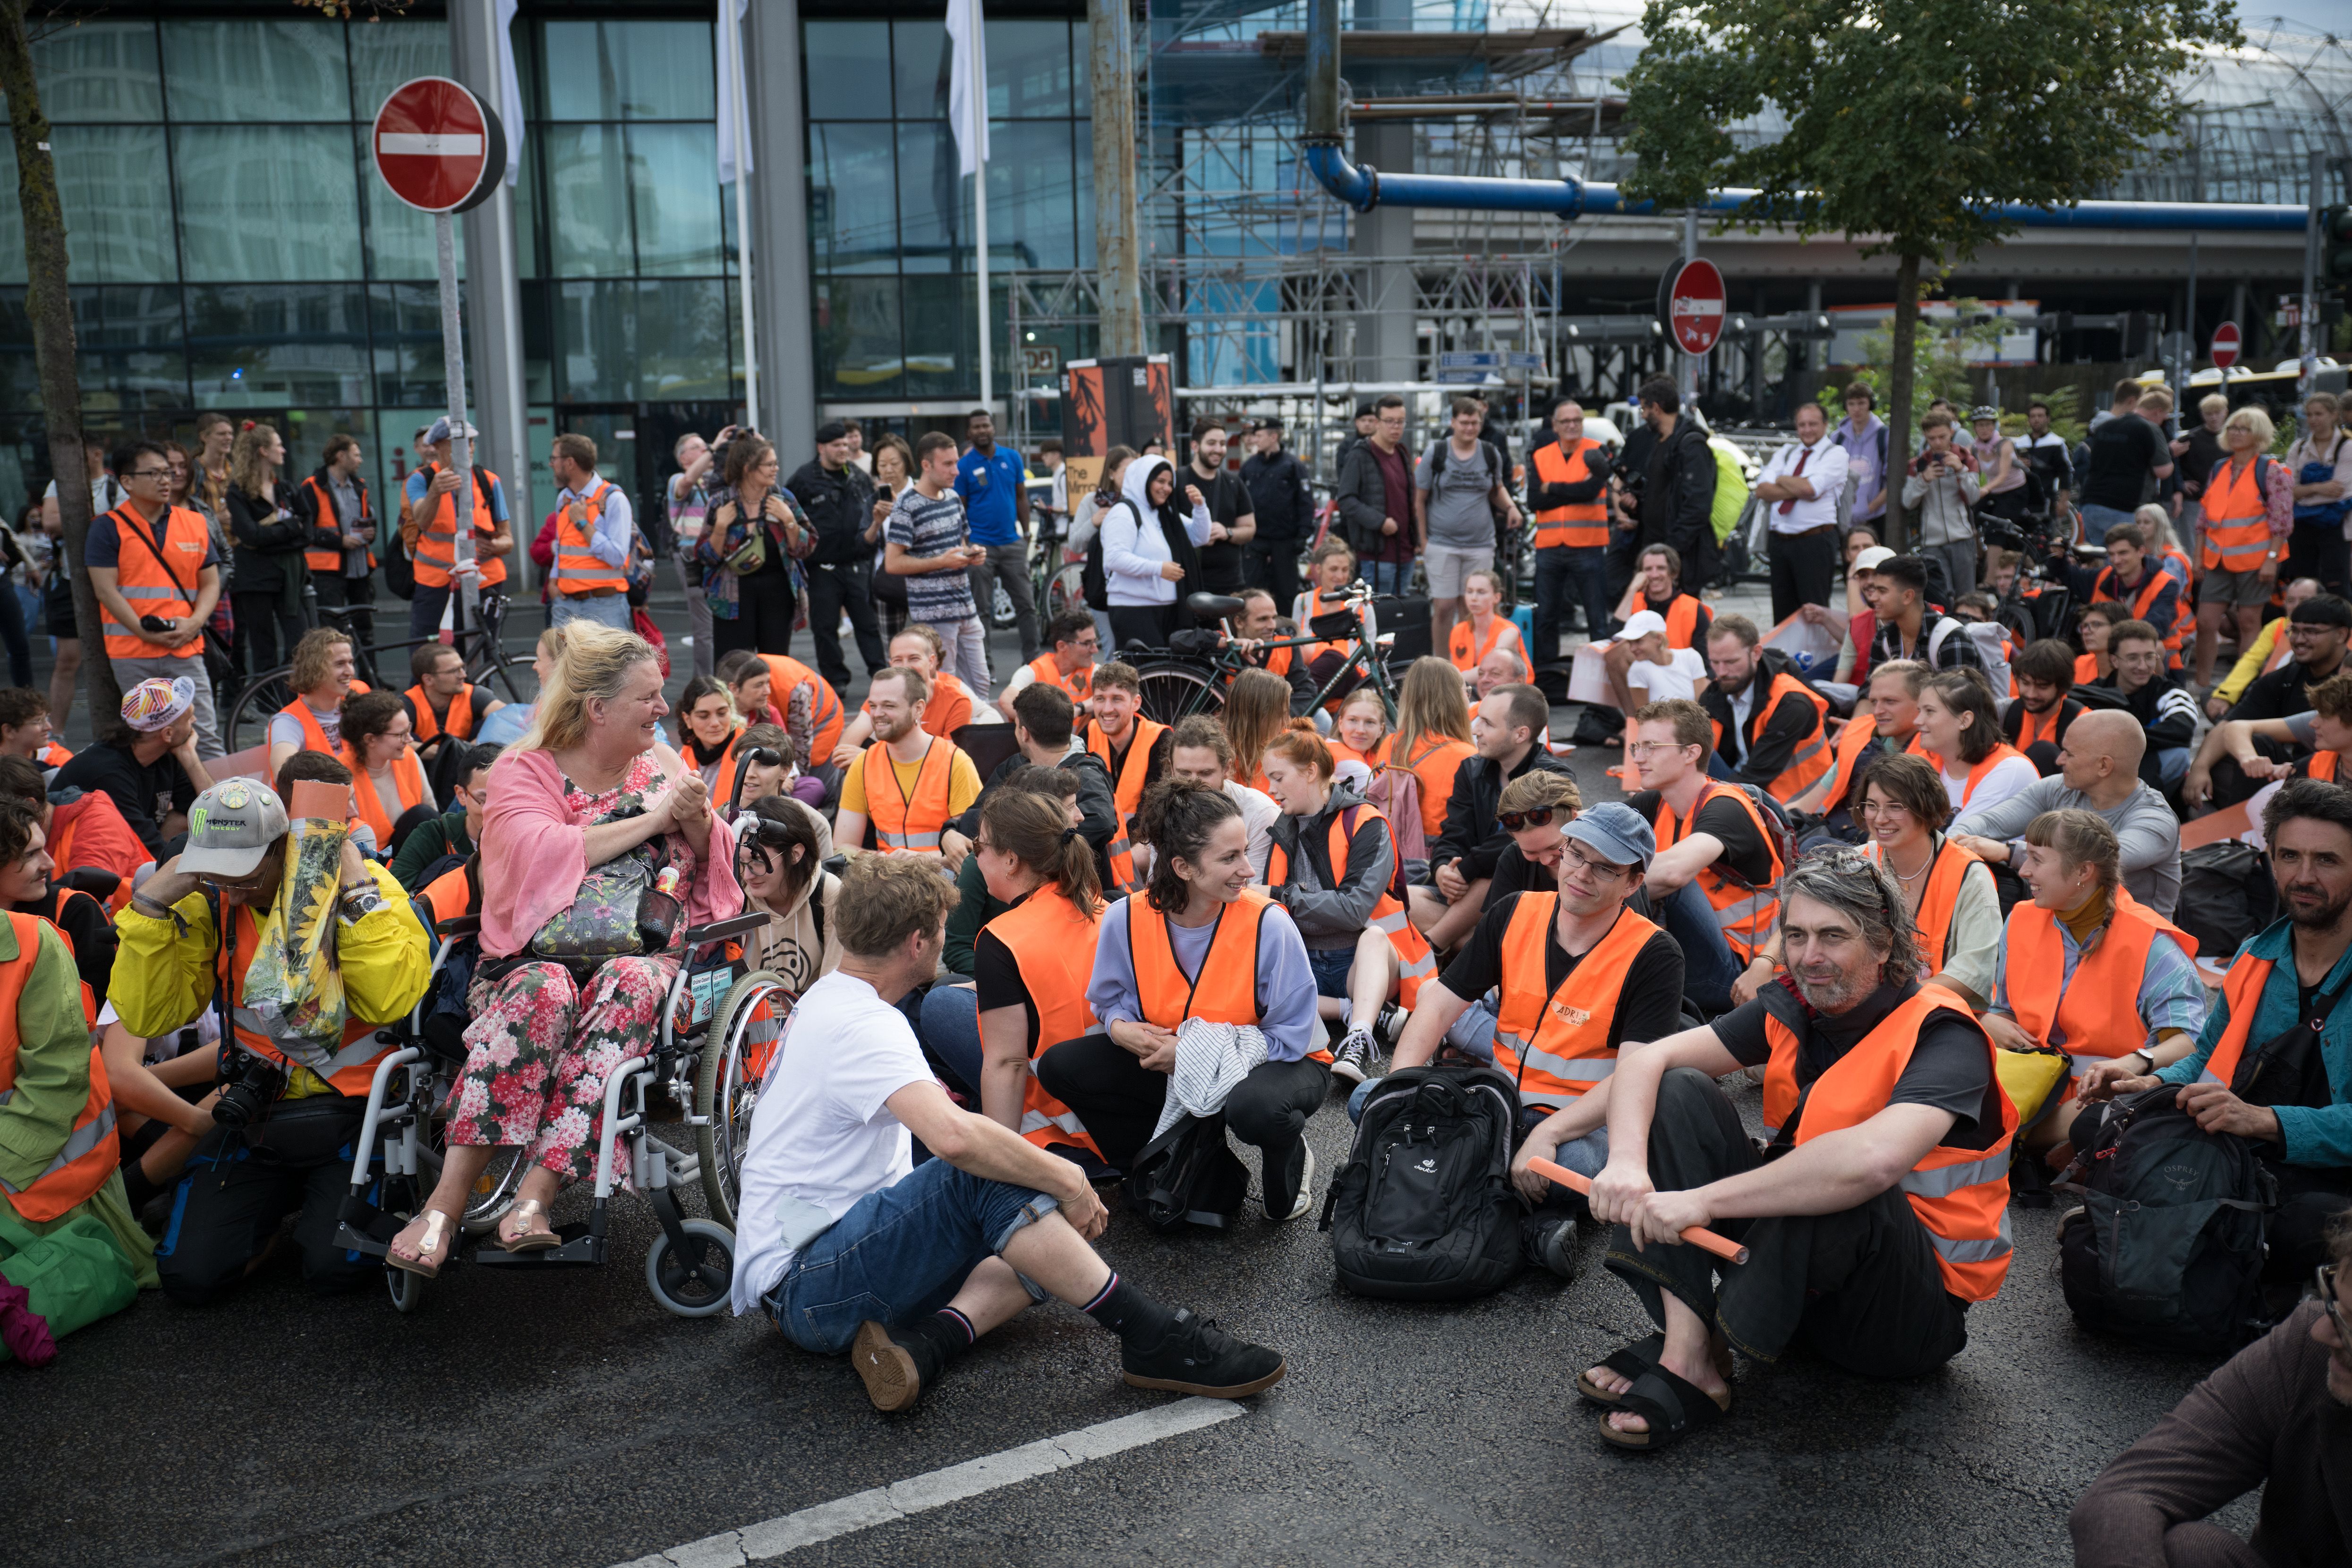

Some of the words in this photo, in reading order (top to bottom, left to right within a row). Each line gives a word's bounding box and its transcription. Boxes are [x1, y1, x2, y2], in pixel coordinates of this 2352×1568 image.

[1025, 351, 1052, 373] DB
[1067, 465, 1087, 479] The
[1067, 481, 1097, 494] Mirro
[206, 818, 247, 827] MONSTER
[1414, 1164, 1438, 1174] deuter
[2164, 1165, 2199, 1176] OSPREY
